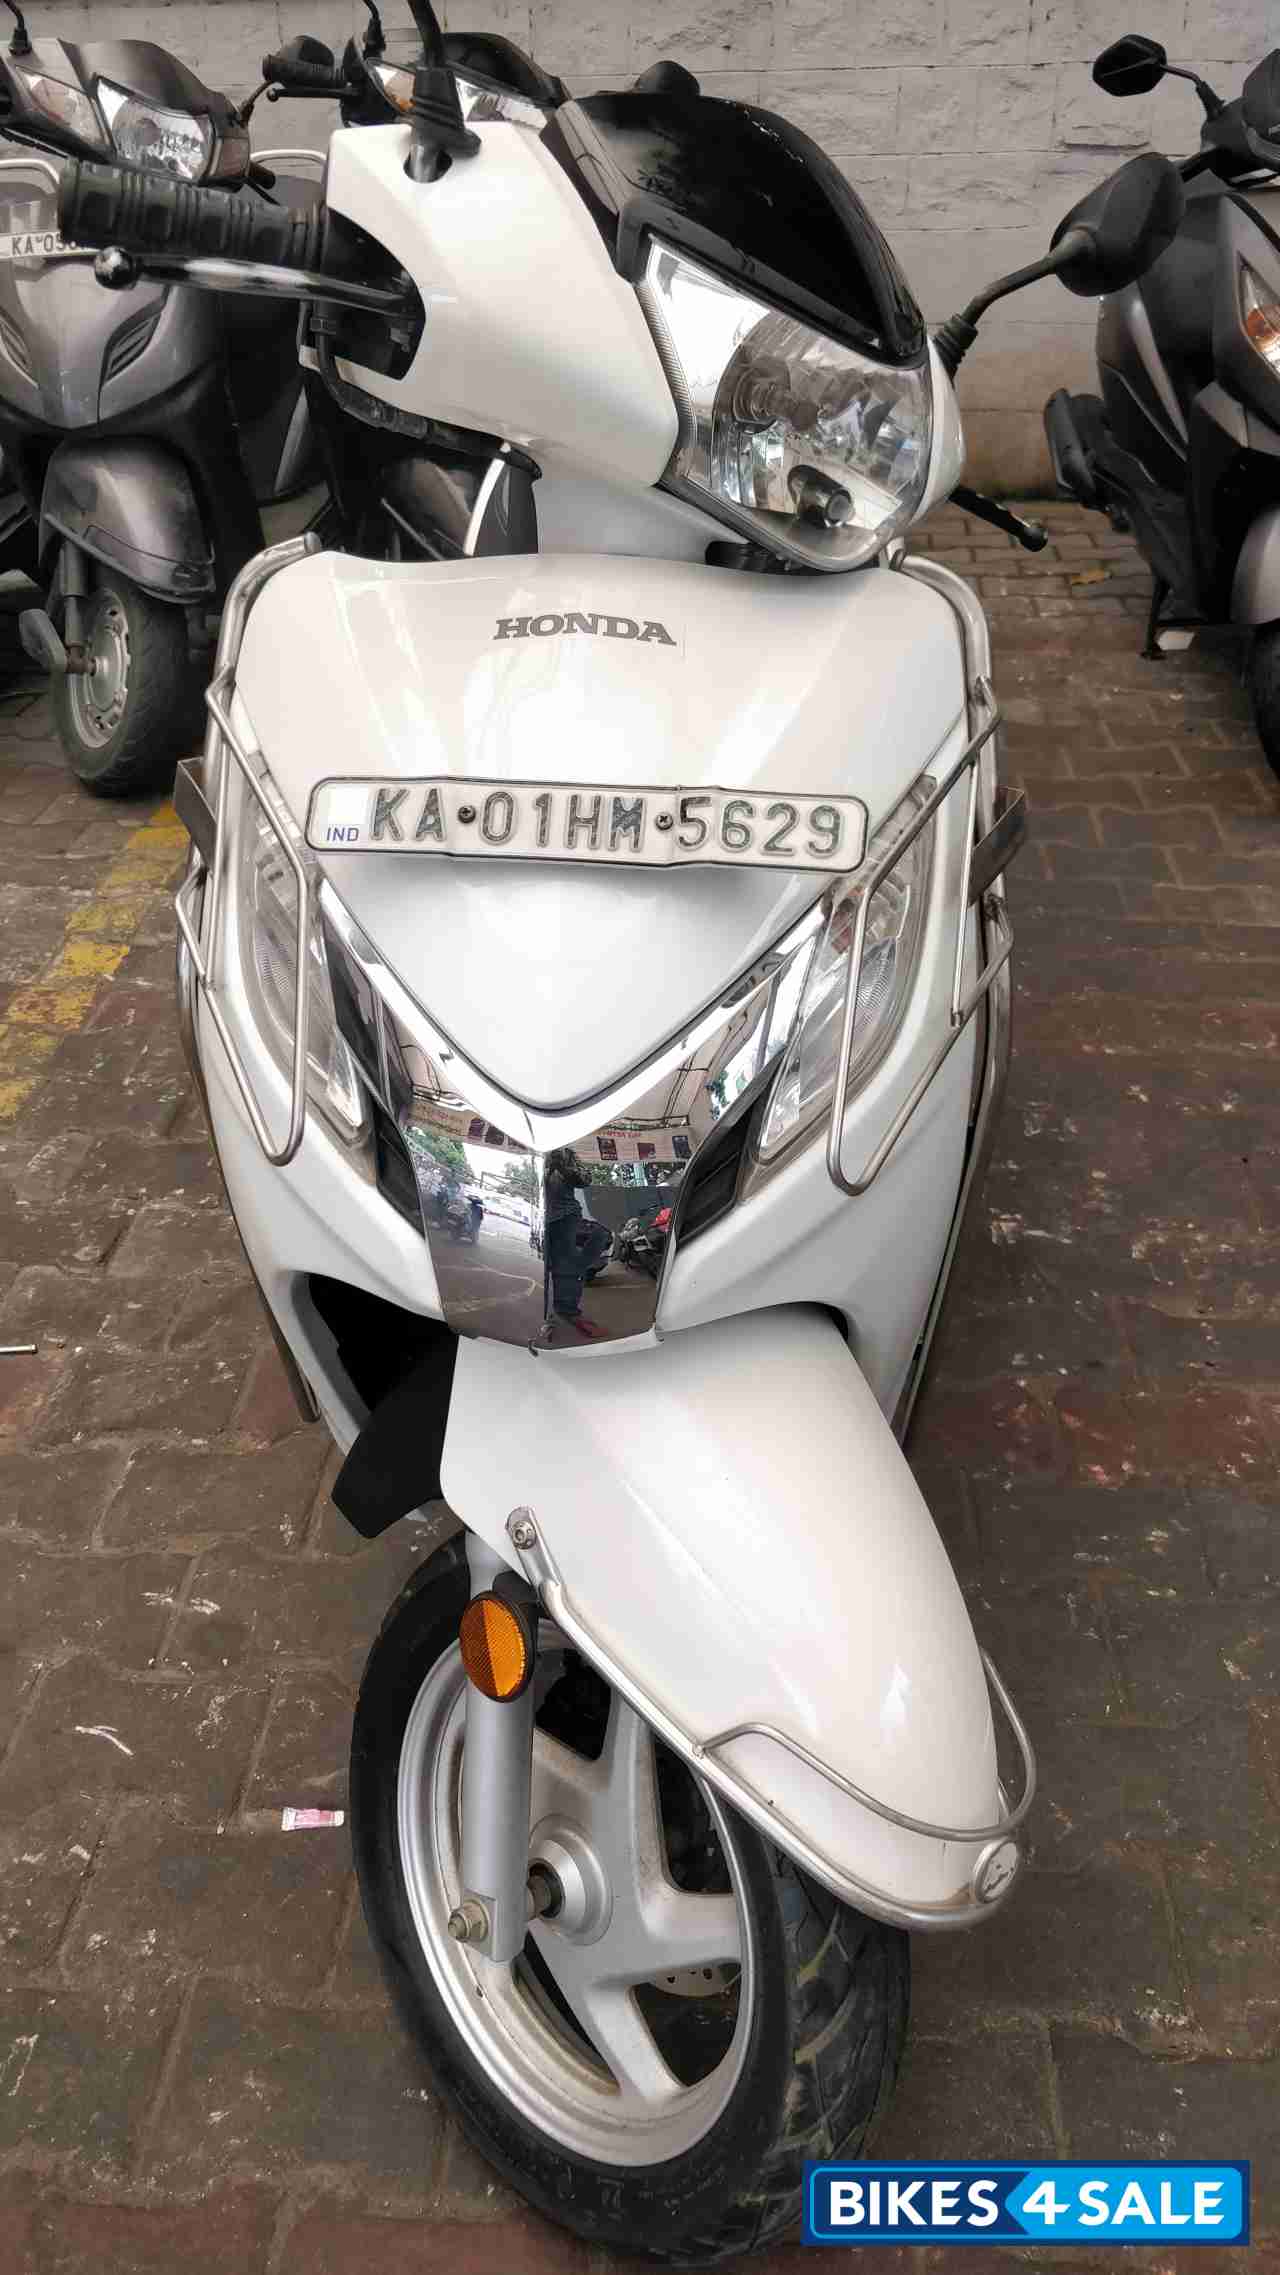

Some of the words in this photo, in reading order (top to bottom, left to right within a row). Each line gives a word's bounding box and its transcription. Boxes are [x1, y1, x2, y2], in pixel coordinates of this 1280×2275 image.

[12, 235, 33, 255] KA
[493, 612, 677, 646] HONDA
[325, 825, 360, 844] IND
[370, 787, 448, 842] KA
[675, 795, 846, 859] 5629
